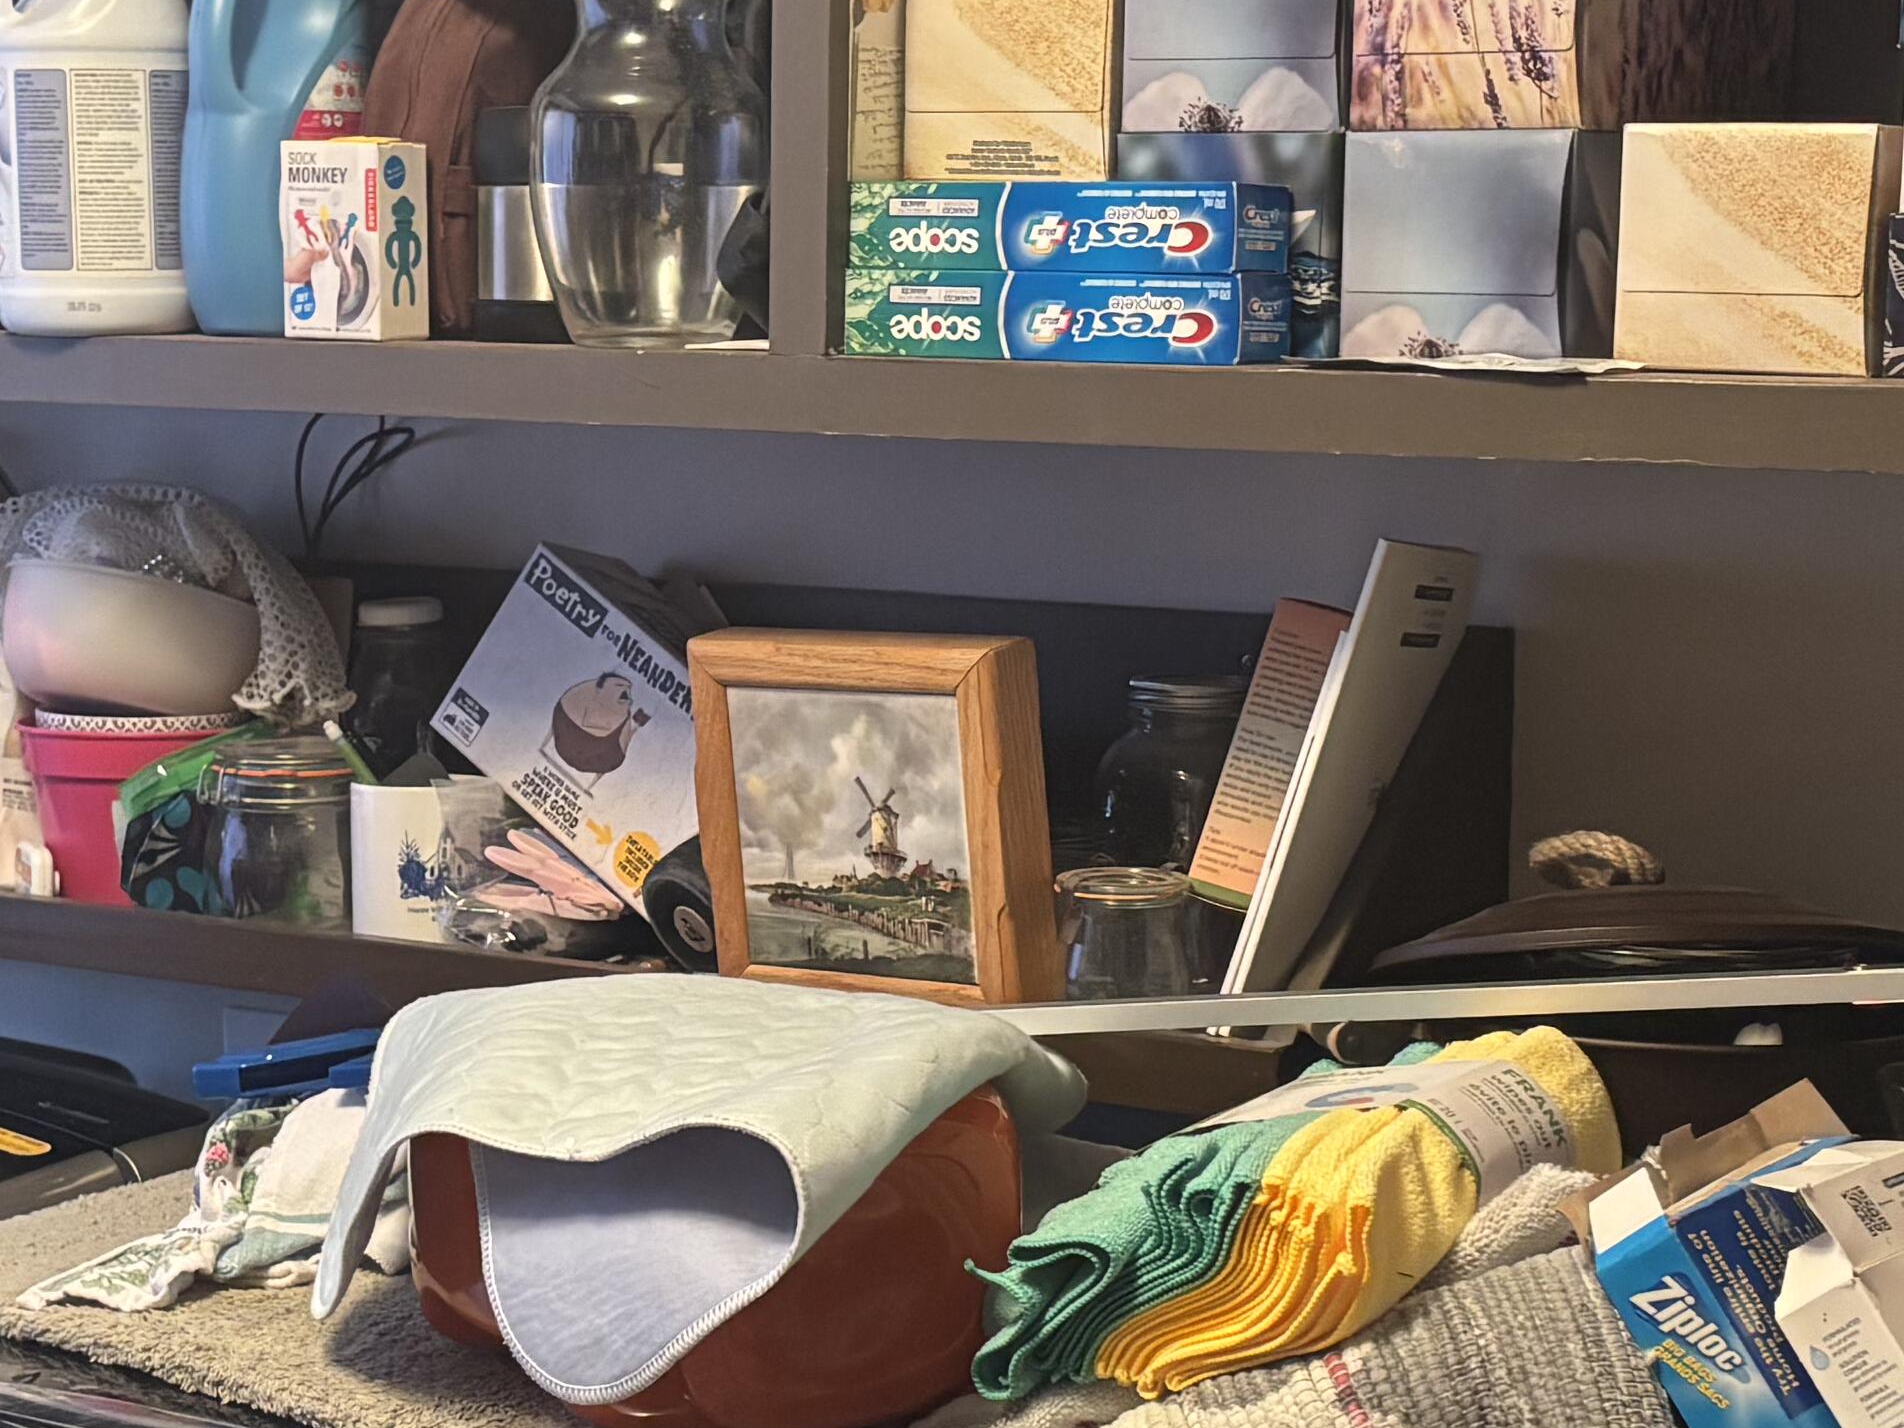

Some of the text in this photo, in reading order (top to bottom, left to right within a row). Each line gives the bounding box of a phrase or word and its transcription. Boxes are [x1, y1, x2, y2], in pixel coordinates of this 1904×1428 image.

[288, 151, 317, 166] SOCK
[288, 167, 348, 184] MONKEY
[1107, 204, 1178, 221] complete
[888, 220, 980, 254] scope
[1069, 220, 1213, 257] Crest
[888, 307, 982, 342] scope
[1111, 294, 1183, 311] complete
[1071, 309, 1217, 348] Crest
[529, 557, 694, 721] Poetry FOR NEANDER
[520, 773, 580, 829] SPEAK GOOD
[532, 766, 555, 792] WHERE
[561, 793, 583, 814] MUST
[1491, 1074, 1552, 1148] wipes out
[1501, 1068, 1567, 1148] FRANK
[1629, 1275, 1745, 1371] Ziploc
[1687, 1232, 1792, 1396] Try the entire line of
[1699, 1228, 1801, 1388] Home Organization
[1653, 1345, 1731, 1410] GRANDS SACS
[1662, 1338, 1717, 1383] BIG BAGS
